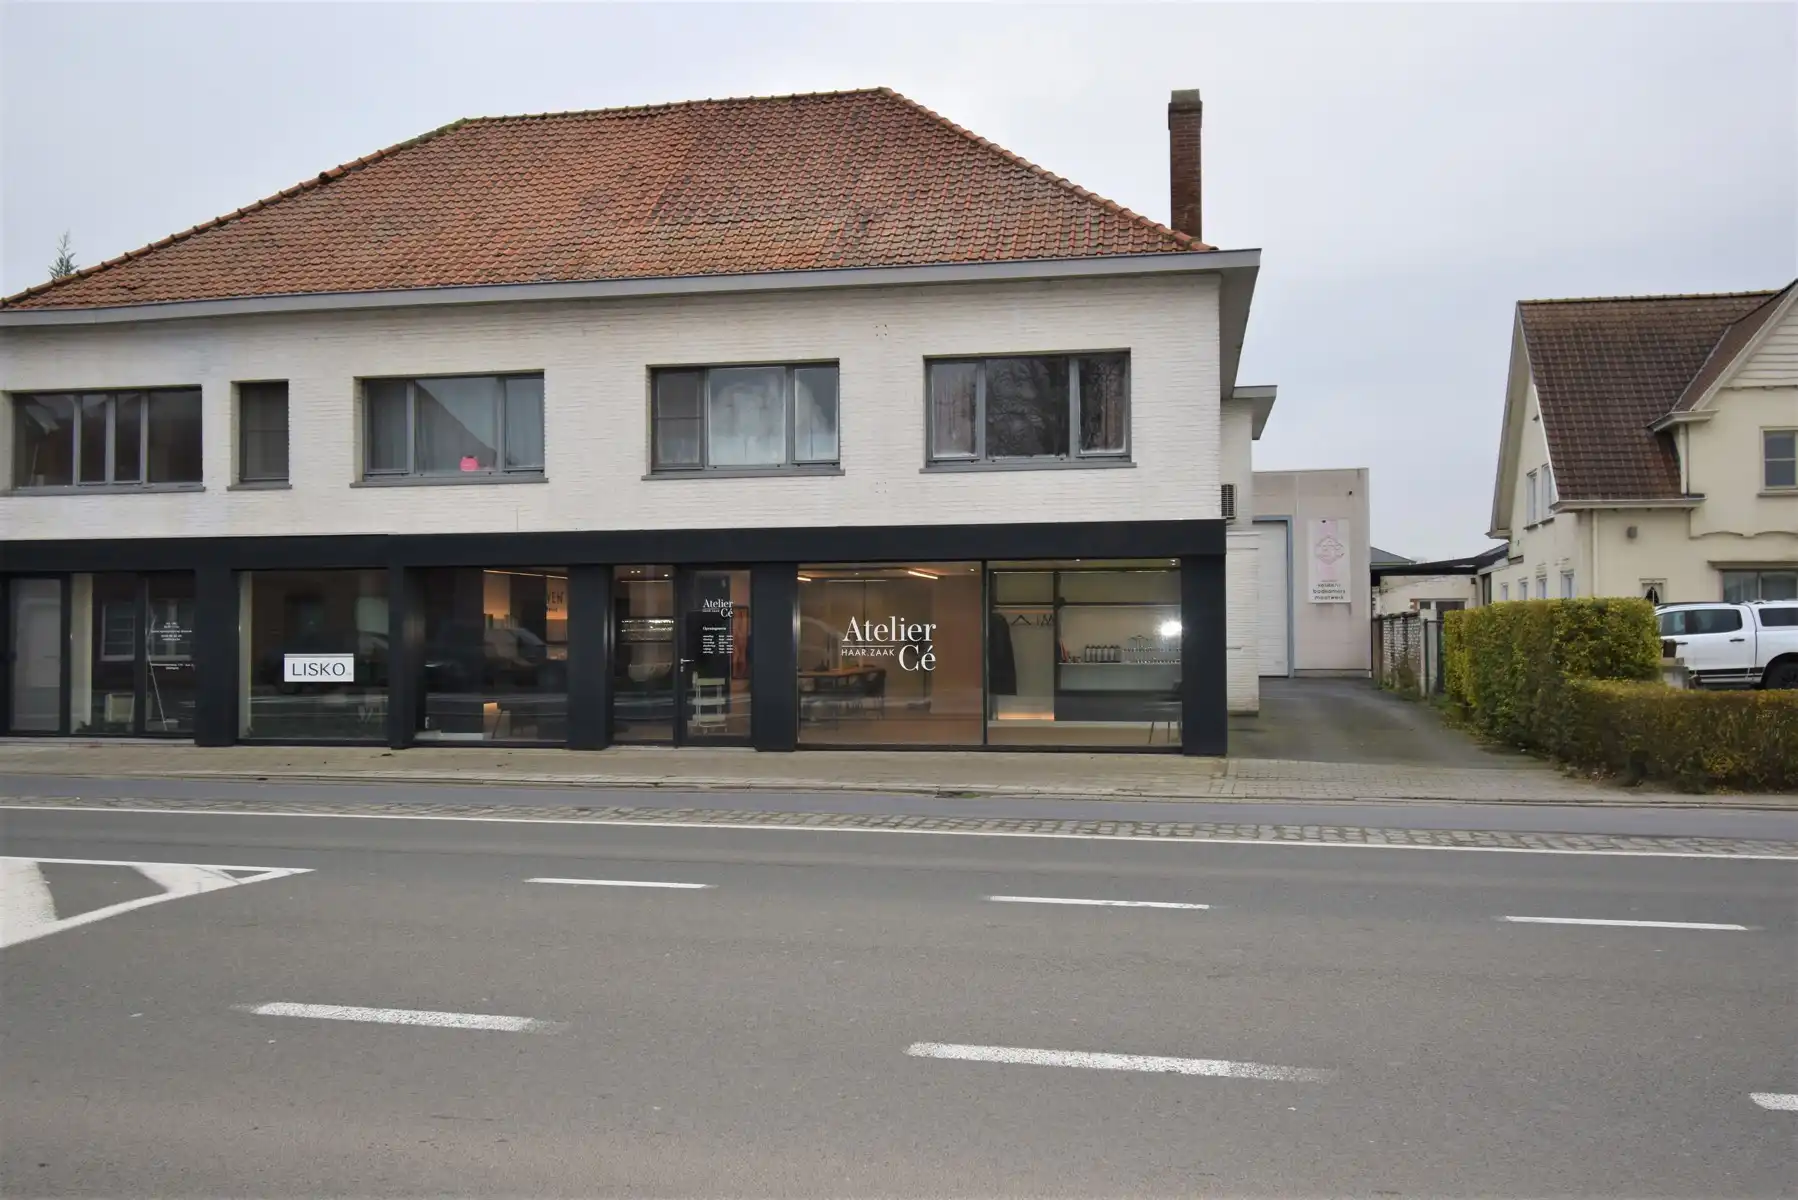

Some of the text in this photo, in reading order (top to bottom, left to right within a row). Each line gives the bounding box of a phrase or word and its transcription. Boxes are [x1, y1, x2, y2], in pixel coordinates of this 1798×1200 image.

[703, 599, 734, 608] Atelier
[720, 607, 734, 618] Cé
[842, 616, 937, 642] Atelier
[841, 648, 895, 657] HAAR.ZAAK
[898, 644, 937, 671] Cé
[292, 662, 346, 677] LISKO
